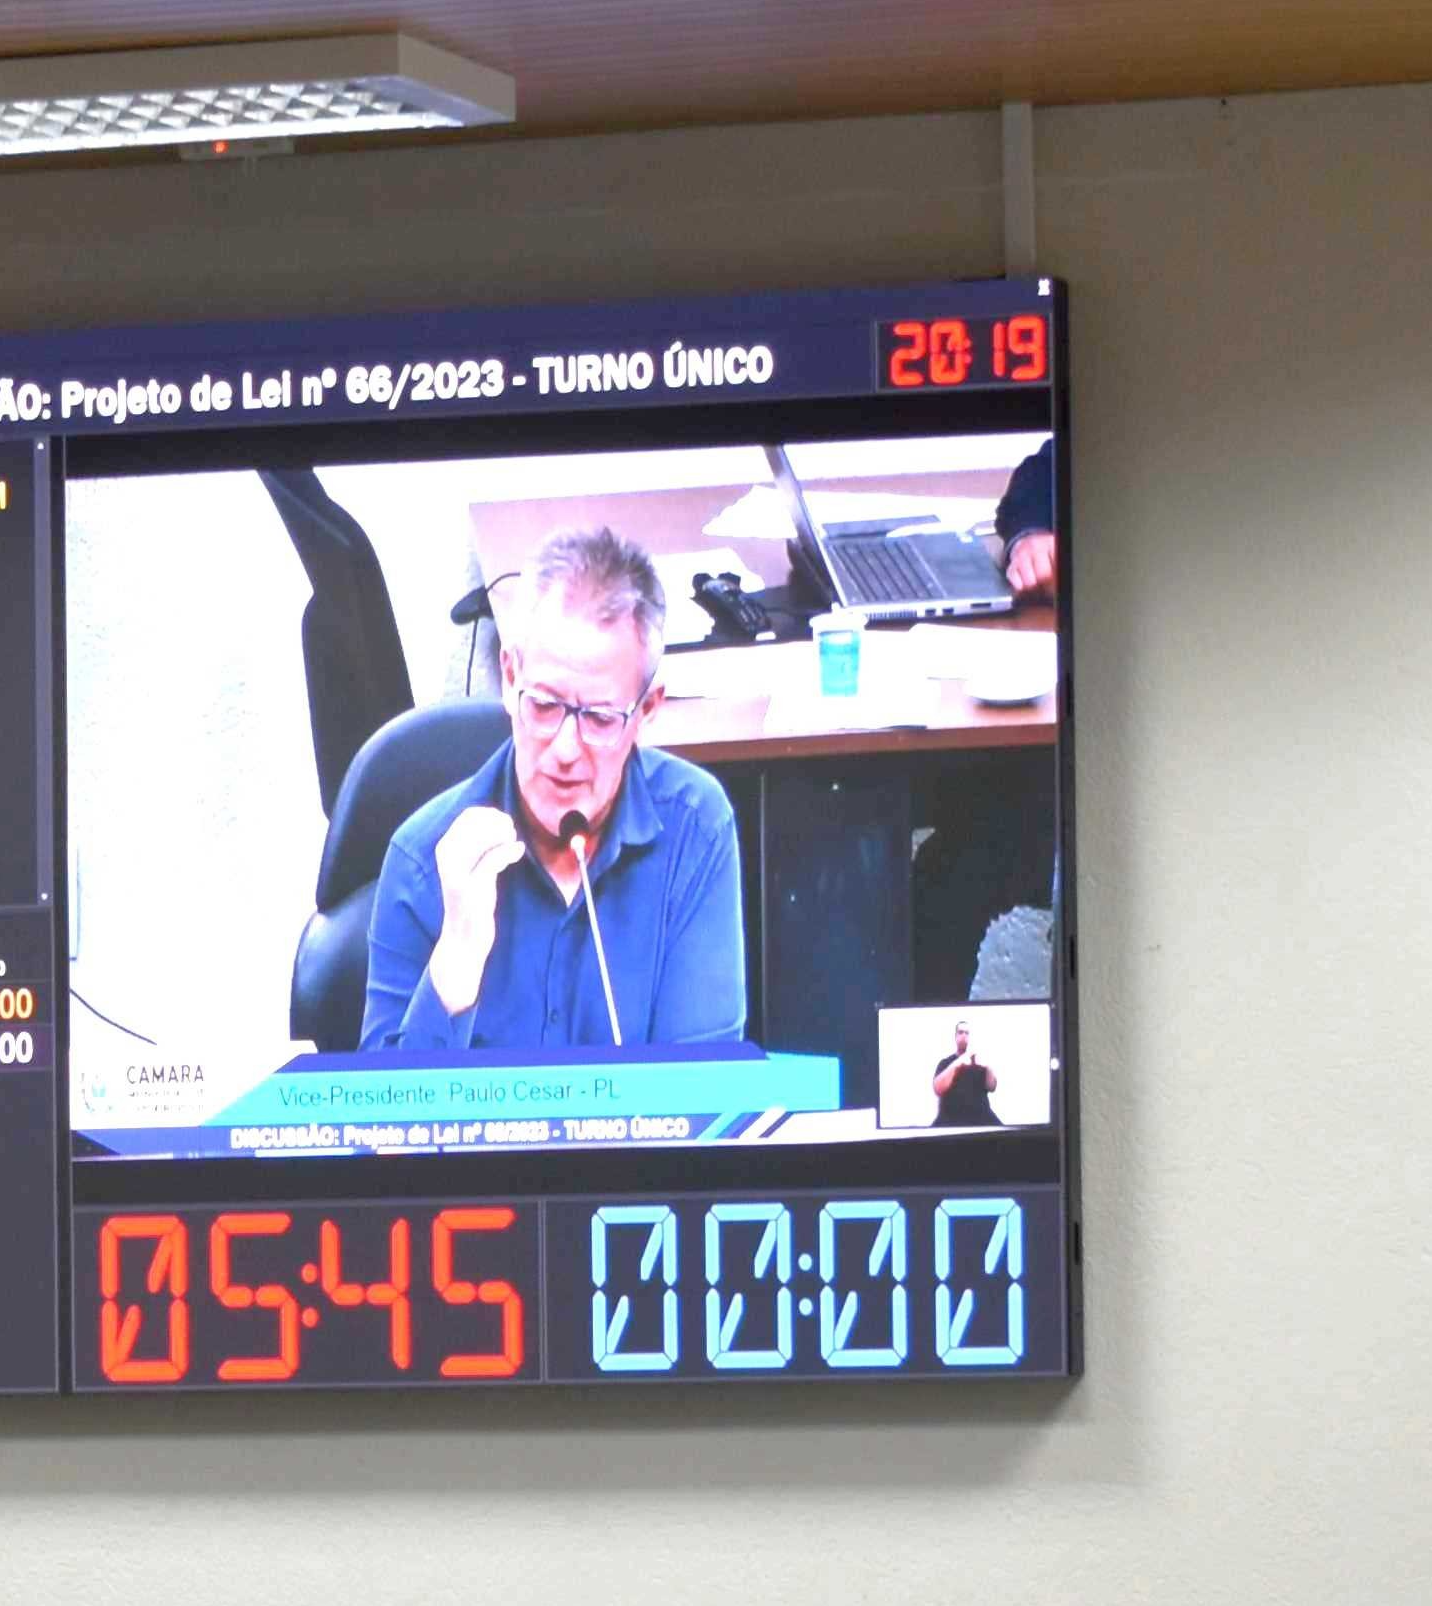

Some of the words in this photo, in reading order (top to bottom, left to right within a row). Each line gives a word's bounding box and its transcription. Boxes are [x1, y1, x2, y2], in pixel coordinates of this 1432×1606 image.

[61, 378, 182, 424] Projeto
[190, 374, 232, 412] de
[242, 369, 291, 409] Lei
[345, 359, 504, 410] 66/2023
[533, 351, 654, 395] TURNO
[663, 340, 774, 388] ÚNICO
[230, 1122, 339, 1149] DISCUSSÃO:
[343, 1124, 406, 1150] Projeto
[407, 1123, 430, 1145] de
[433, 1122, 460, 1145] Lei
[563, 1118, 627, 1141] TURNO
[630, 1114, 690, 1139] ÚNICO
[279, 1085, 436, 1107] Vice-Presidente
[450, 1081, 507, 1104] Paulo
[513, 1080, 572, 1101] Cesar
[594, 1078, 622, 1100] PL
[99, 1208, 525, 1381] 05:45
[590, 1196, 1025, 1371] 00:00
